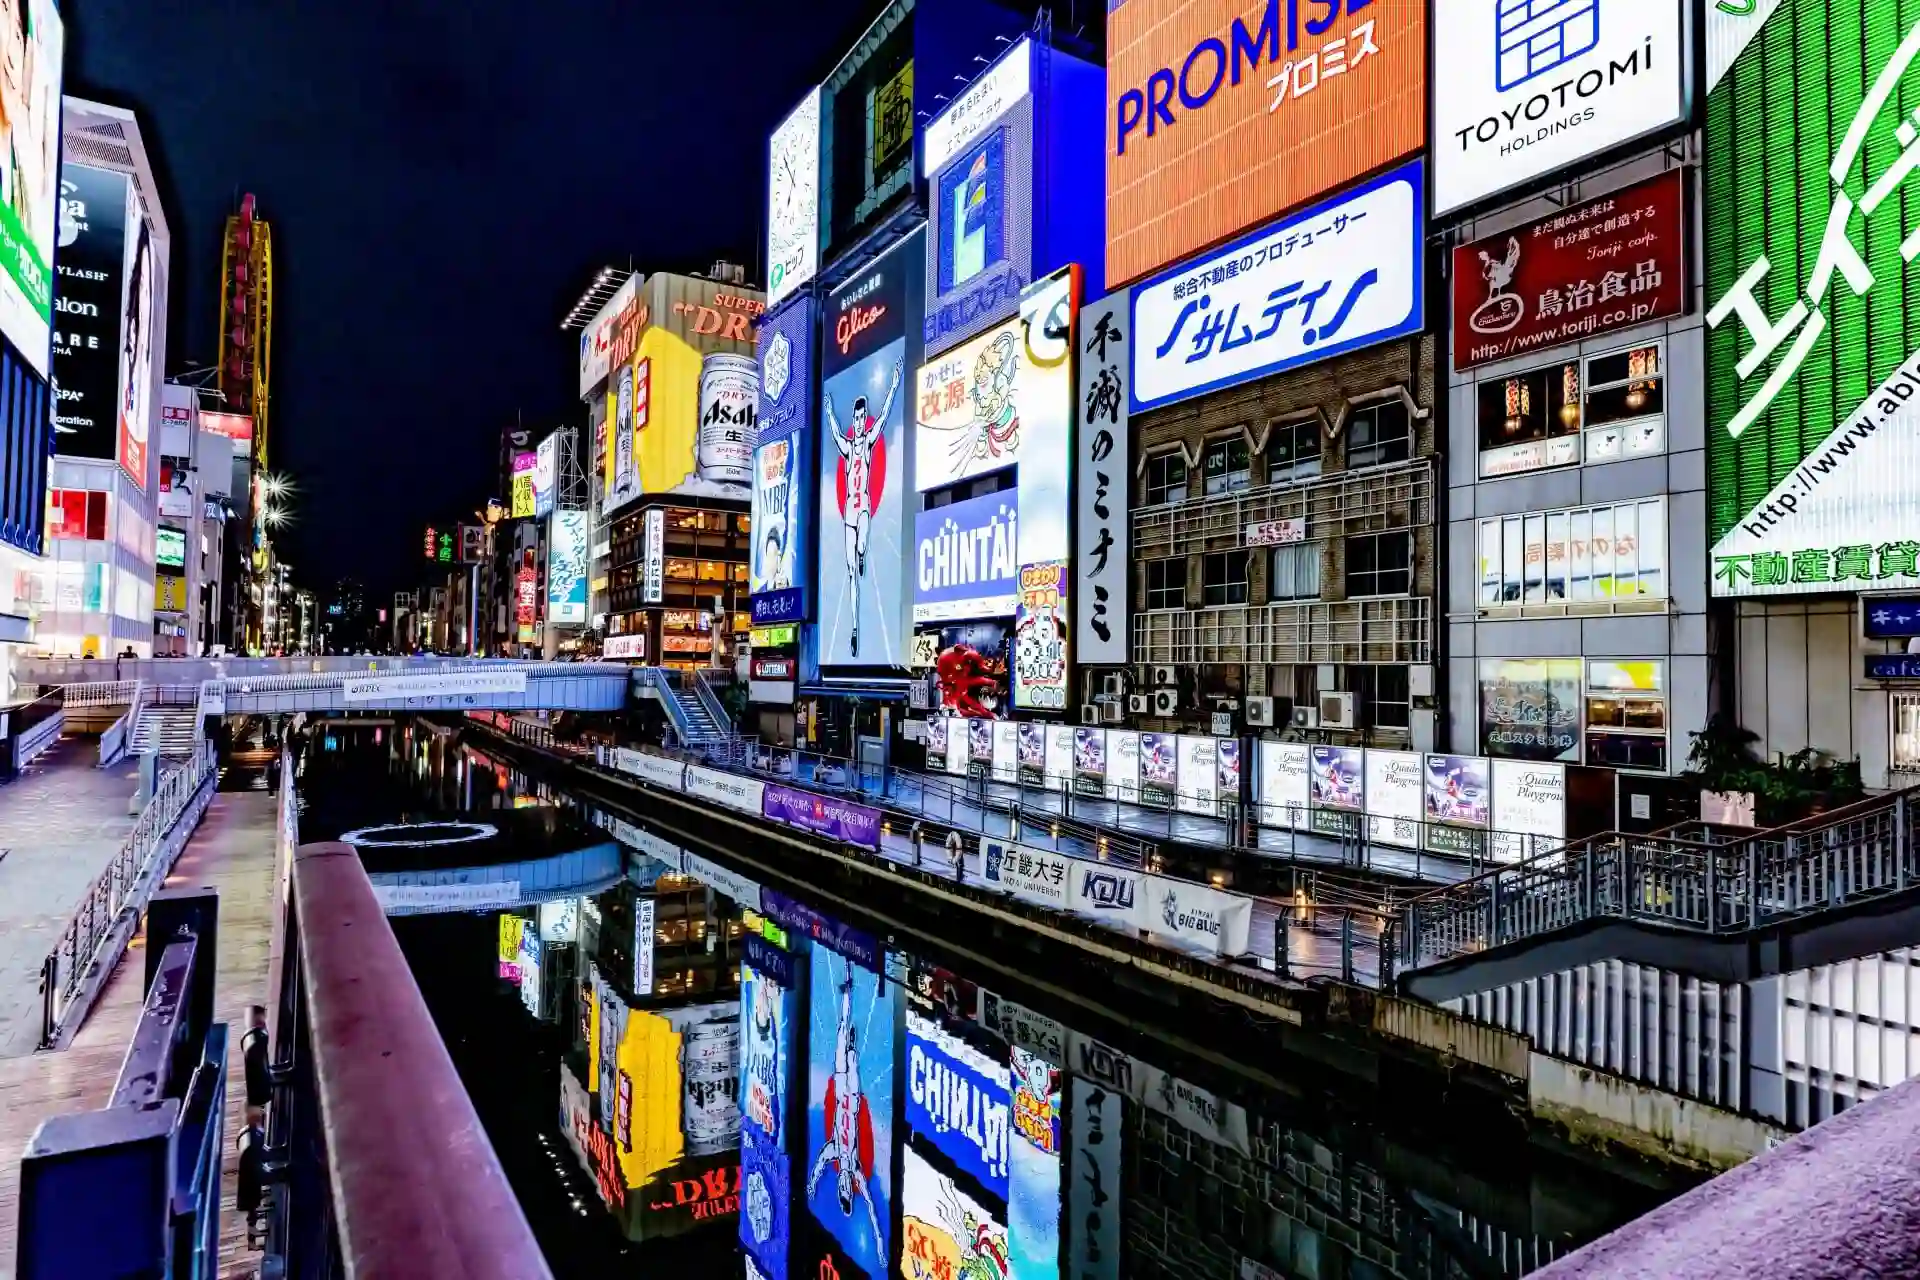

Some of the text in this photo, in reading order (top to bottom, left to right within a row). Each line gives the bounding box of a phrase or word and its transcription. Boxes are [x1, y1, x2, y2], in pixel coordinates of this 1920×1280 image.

[1117, 0, 1373, 157] PROMI
[1267, 19, 1380, 114] プロミス
[1500, 107, 1596, 157] HOLDINGS
[1554, 204, 1657, 251] 自分達で創造する
[1586, 240, 1623, 261] Toriji
[1173, 211, 1367, 301] 総合不動産のプロデューサー
[713, 293, 766, 315] SUPER
[1535, 258, 1662, 321] 鳥治食品
[837, 306, 886, 354] Glico
[1471, 297, 1658, 361] http://www.toriji.co.jp/
[703, 398, 758, 430] Asah
[921, 377, 966, 422] 改源
[725, 429, 743, 442] 生
[1742, 363, 1920, 539] http://www.abl
[1871, 609, 1920, 626] ギャ
[1212, 713, 1230, 725] BAR
[1024, 881, 1061, 898] UNIVERSIT
[1196, 919, 1221, 936] BLUE
